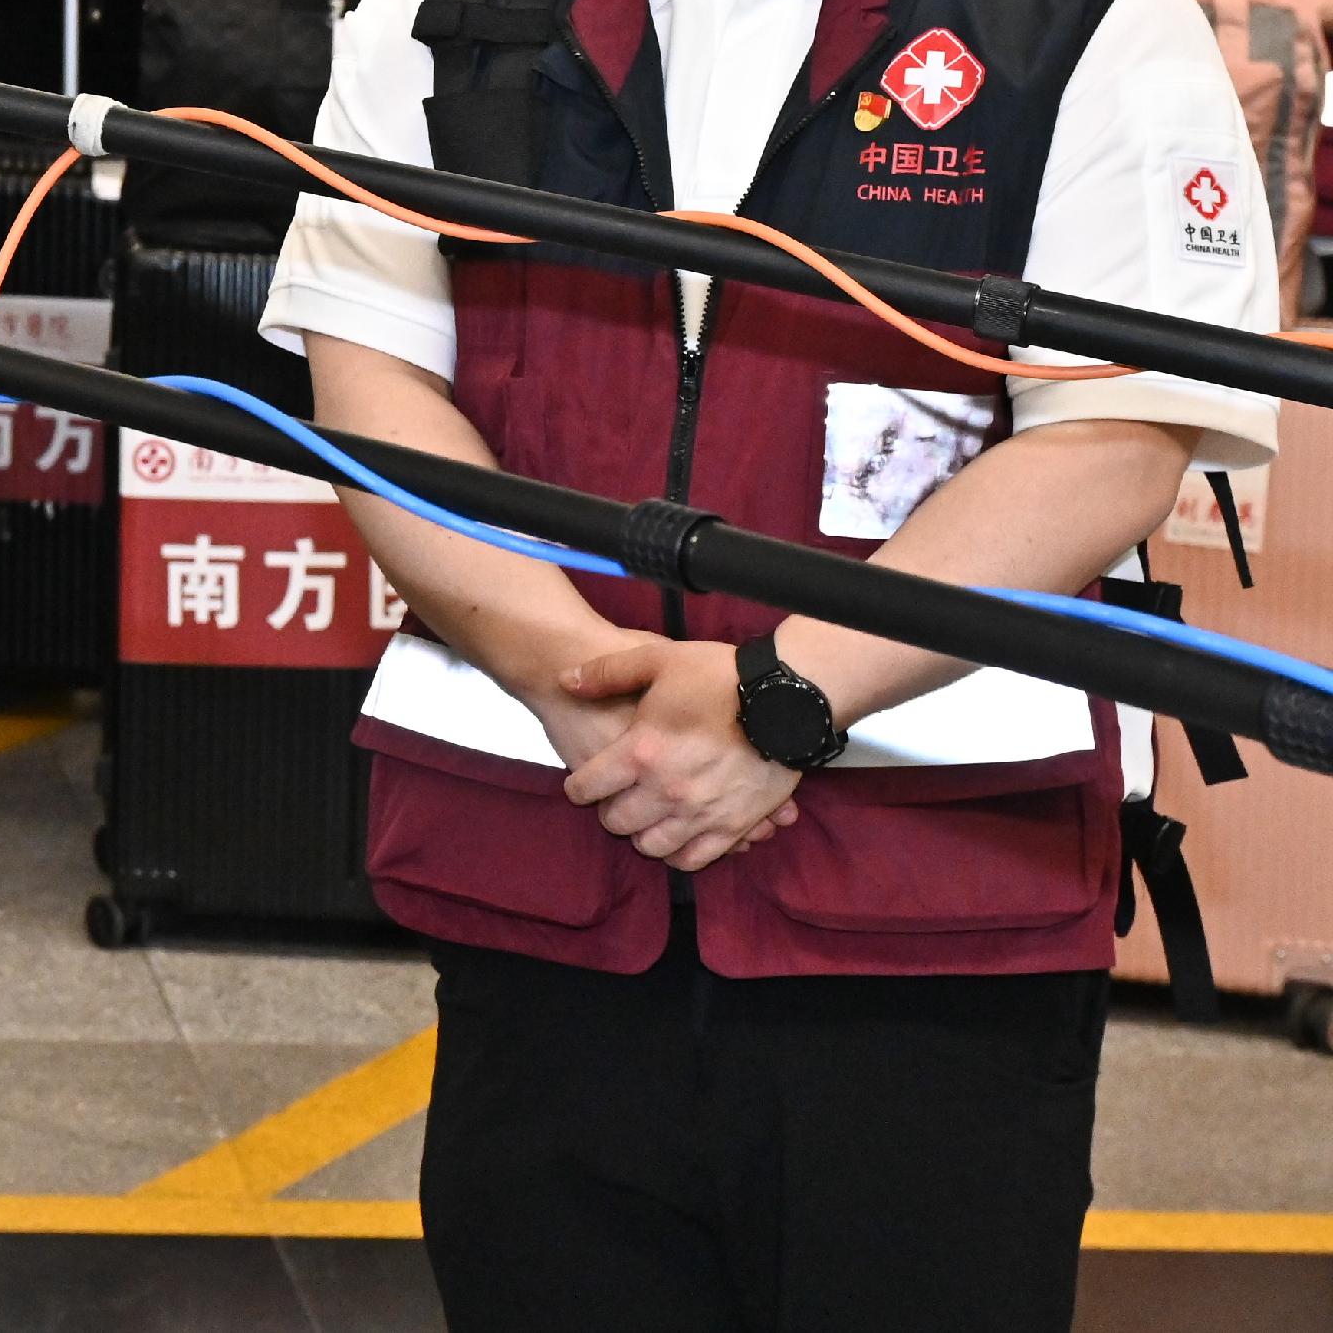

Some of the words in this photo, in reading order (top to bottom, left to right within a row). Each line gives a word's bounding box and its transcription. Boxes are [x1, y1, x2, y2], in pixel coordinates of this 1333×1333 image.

[859, 141, 986, 178] 中国卫生
[857, 183, 912, 202] CHINA
[1184, 222, 1241, 246] 中国卫生
[1185, 243, 1211, 253] CHINA
[1213, 246, 1240, 257] HEALTH
